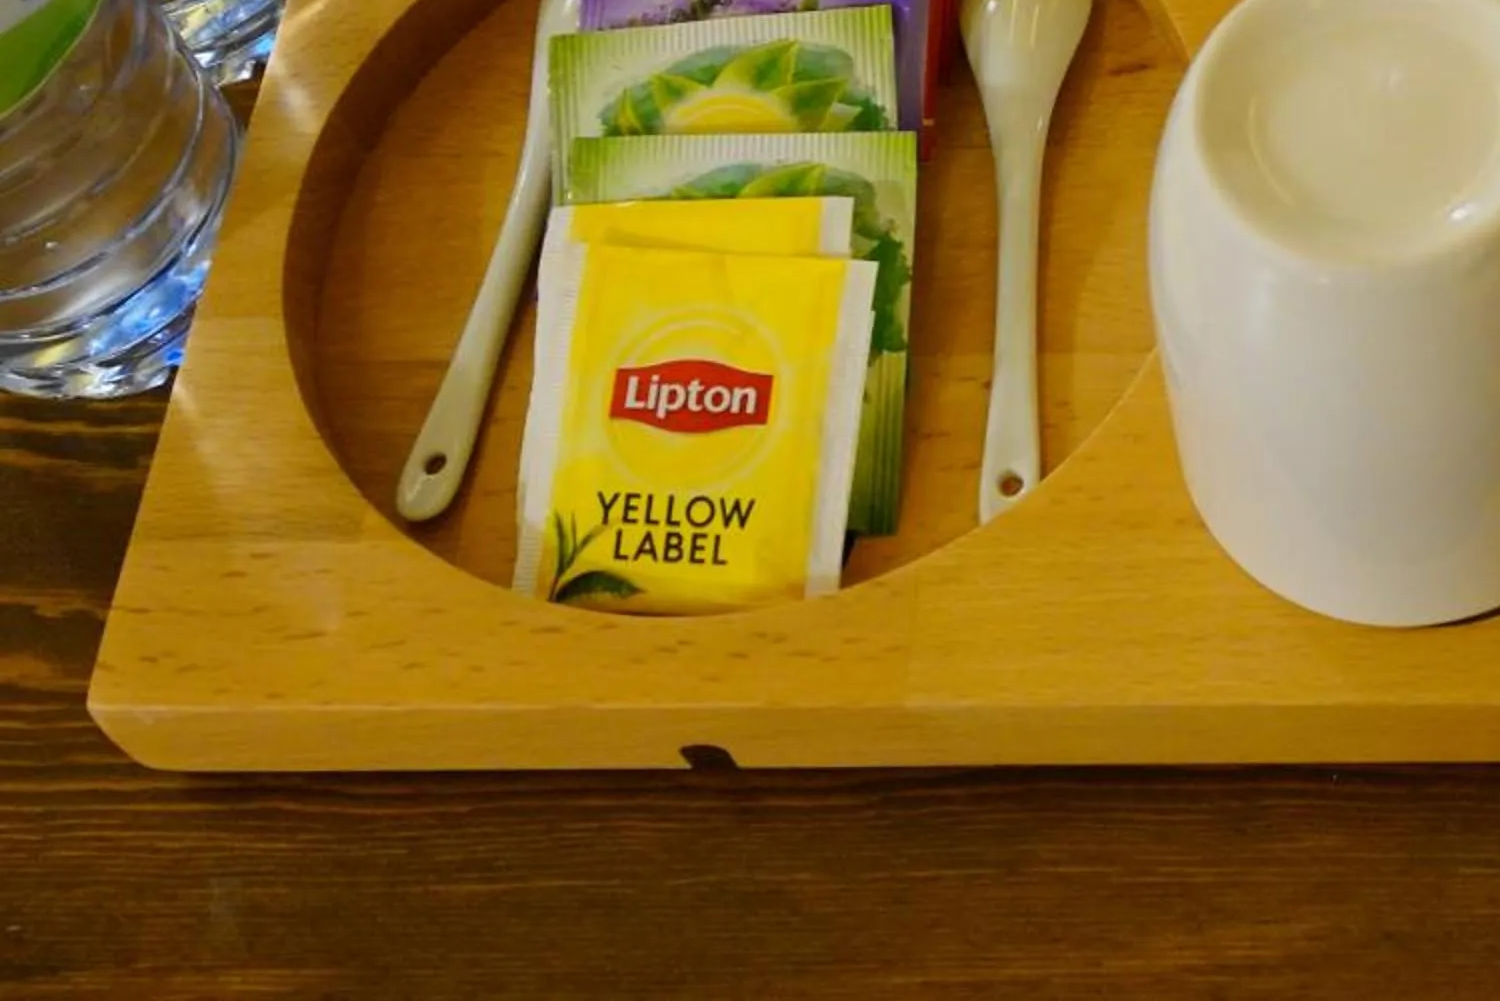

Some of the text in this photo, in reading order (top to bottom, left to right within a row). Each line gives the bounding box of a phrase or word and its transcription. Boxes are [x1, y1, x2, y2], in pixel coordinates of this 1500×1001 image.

[623, 374, 759, 420] Lipton
[597, 492, 756, 530] YELLOW
[613, 529, 728, 566] LABEL
